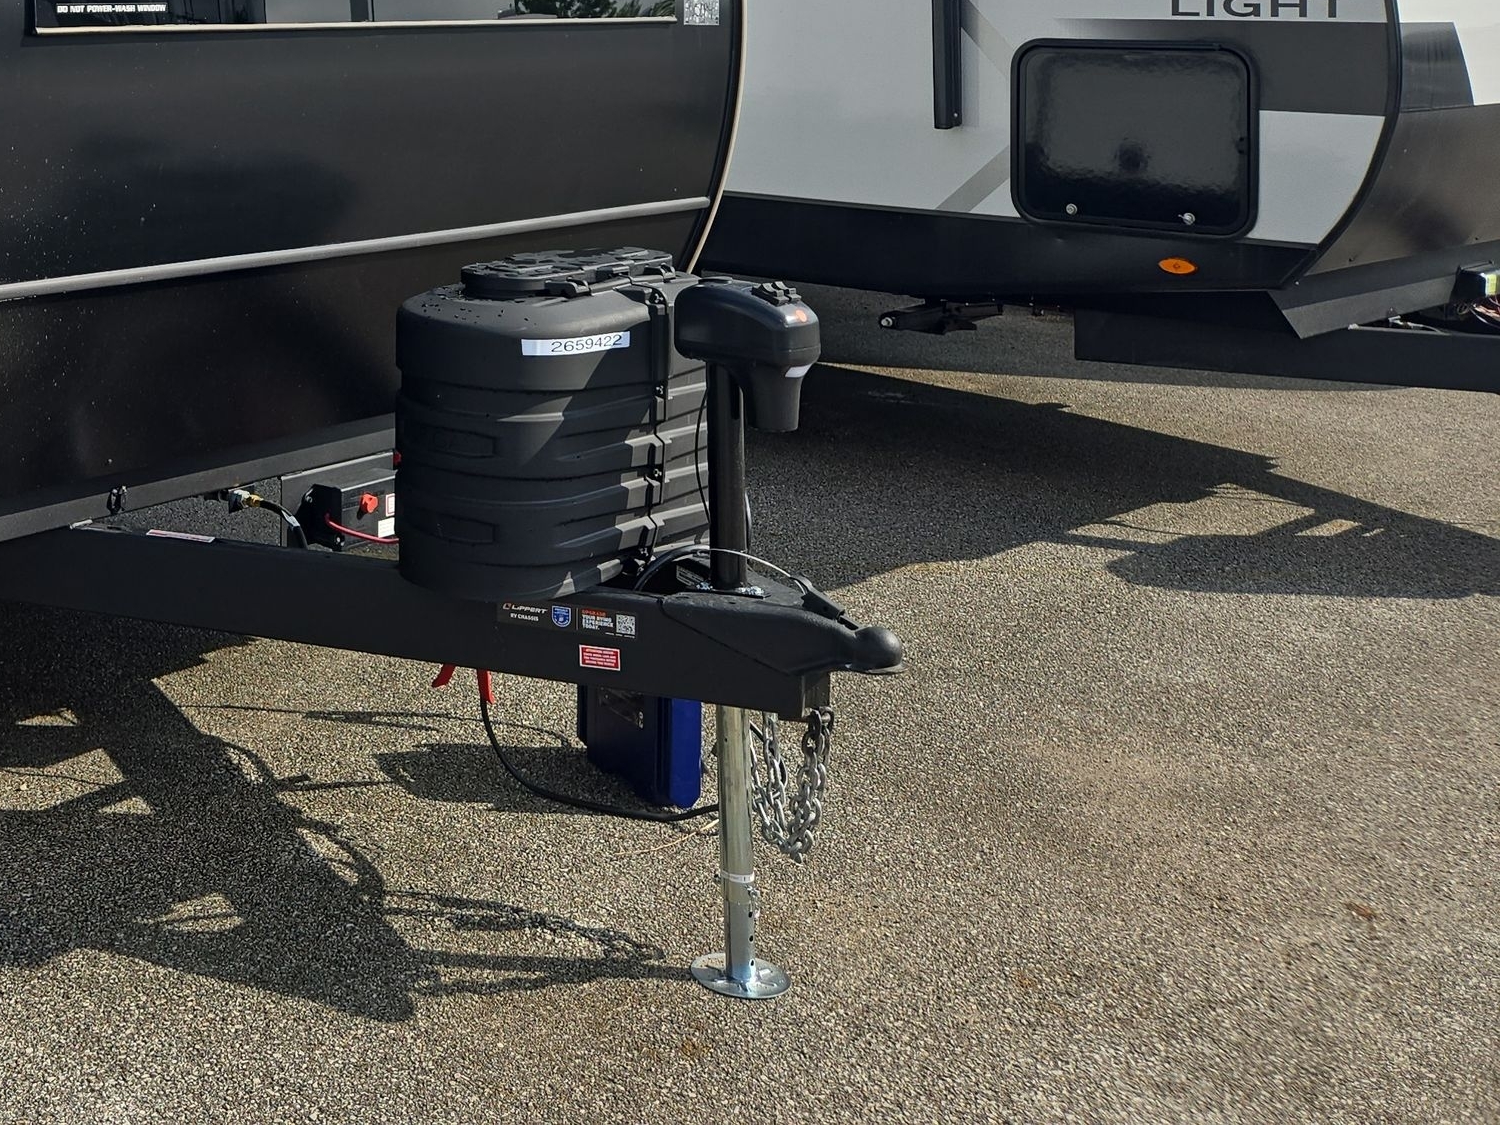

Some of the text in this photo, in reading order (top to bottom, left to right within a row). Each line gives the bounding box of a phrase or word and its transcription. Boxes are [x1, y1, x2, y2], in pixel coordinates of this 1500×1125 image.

[57, 5, 68, 13] DO
[69, 5, 85, 13] NOT
[136, 4, 167, 12] WINDOW
[550, 333, 623, 353] 2659422
